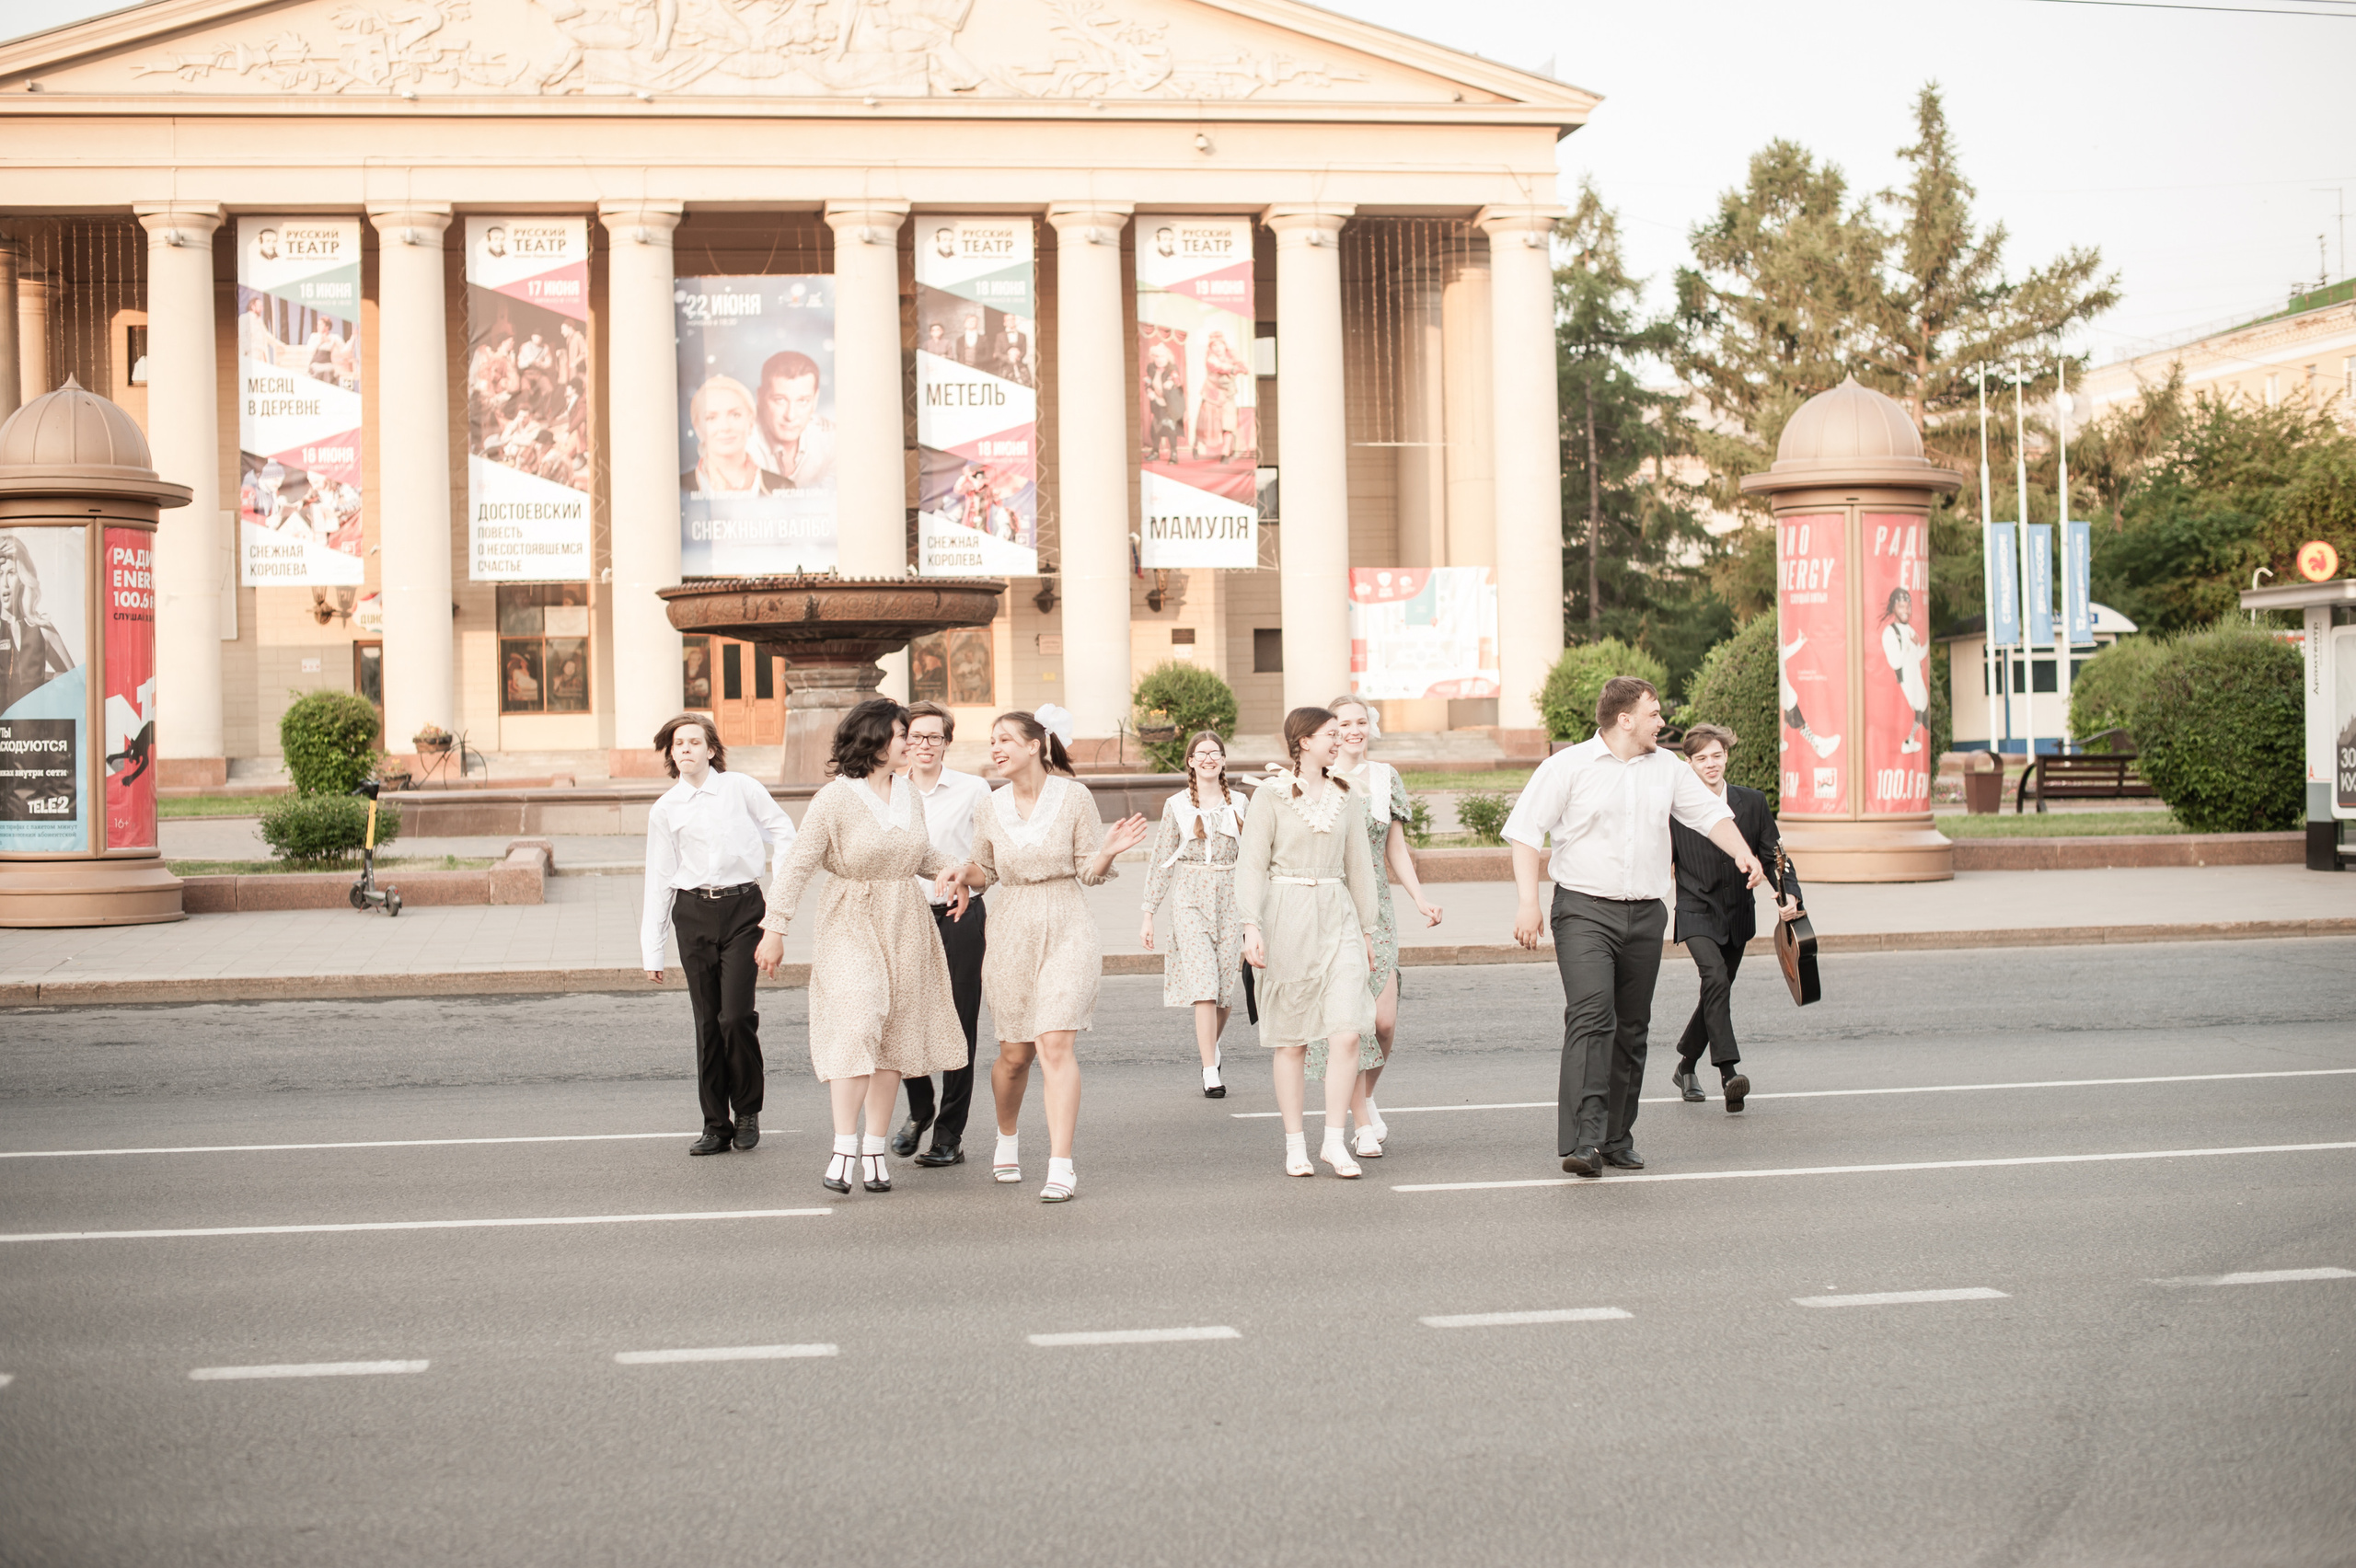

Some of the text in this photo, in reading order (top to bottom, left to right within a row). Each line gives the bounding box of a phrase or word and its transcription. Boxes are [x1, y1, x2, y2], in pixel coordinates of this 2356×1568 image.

[286, 228, 339, 239] РУССКИЙ
[514, 226, 565, 236] РУССКИЙ
[963, 228, 1012, 237] РУССКИЙ
[1183, 227, 1231, 237] РУССКИЙ
[286, 241, 339, 253] ТЕАТР
[514, 239, 566, 251] ТЕАТР
[962, 240, 1013, 252] ТЕАТР
[1183, 239, 1232, 251] ТЕАТР
[300, 282, 352, 298] 16 ИЮНЯ
[528, 280, 580, 296] 17 ИЮНЯ
[976, 281, 989, 295] 18
[1195, 280, 1209, 294] 19
[686, 294, 761, 316] 22 ИЮНЯ
[248, 377, 294, 394] МЕСЯЦ
[926, 383, 1006, 406] МЕТЕЛЬ
[248, 399, 321, 417] В ДЕРЕВНЕ
[977, 440, 1028, 456] 18 ИЮНЯ
[302, 447, 354, 464] 16 ИЮНЯ
[479, 499, 582, 522] ДОСТОЕВСКИЙ
[478, 526, 523, 538] ПОВЕСТЬ
[692, 516, 830, 540] СНЕЖНЫЙ ВАЛЬС
[1149, 516, 1249, 539] МАМУЛЯ
[478, 543, 583, 556] О НЕСОСТОЯВШЕМСЯ
[927, 536, 979, 549] СНЕЖНАЯ
[250, 545, 304, 559] СНЕЖНАЯ
[478, 560, 522, 572] СЧАСТЬЕ
[927, 553, 983, 567] КОРОЛЕВА
[250, 563, 307, 577] КОРОЛЕВА
[113, 591, 149, 609] 100.6
[1877, 768, 1914, 800] 100.6
[28, 796, 69, 813] TELE2
[114, 818, 129, 829] 16+
